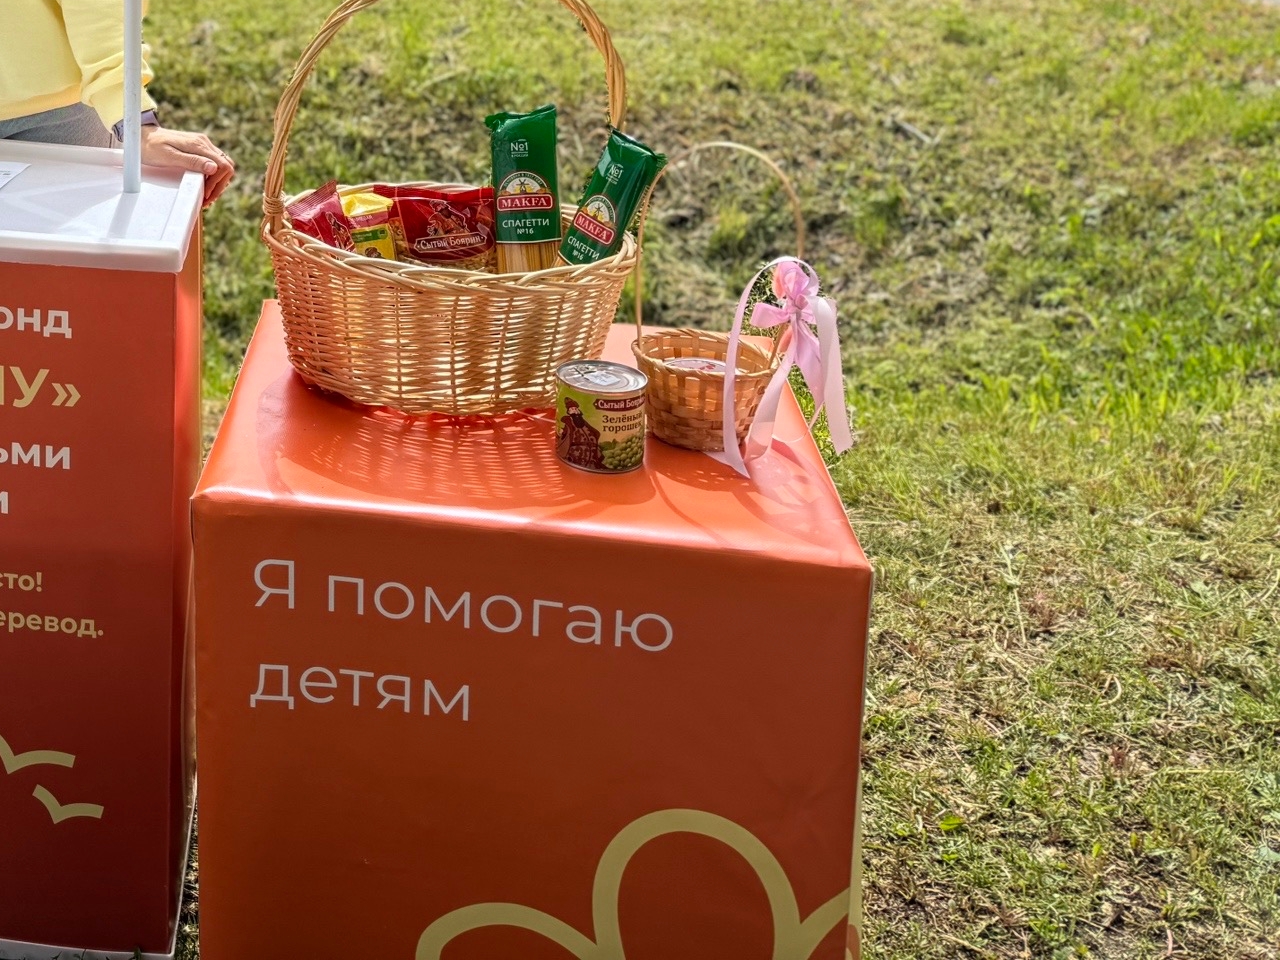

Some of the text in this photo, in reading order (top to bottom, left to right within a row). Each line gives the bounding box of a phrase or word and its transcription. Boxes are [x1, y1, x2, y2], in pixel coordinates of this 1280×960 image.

[502, 197, 547, 208] MAKFA
[502, 219, 549, 227] СПАГЕТТИ
[576, 215, 608, 240] MAKFA
[420, 236, 480, 249] Сытый Боярин
[568, 236, 599, 260] СПАГЕТТИ
[254, 558, 674, 652] Я помогаю
[250, 663, 470, 722] детям
